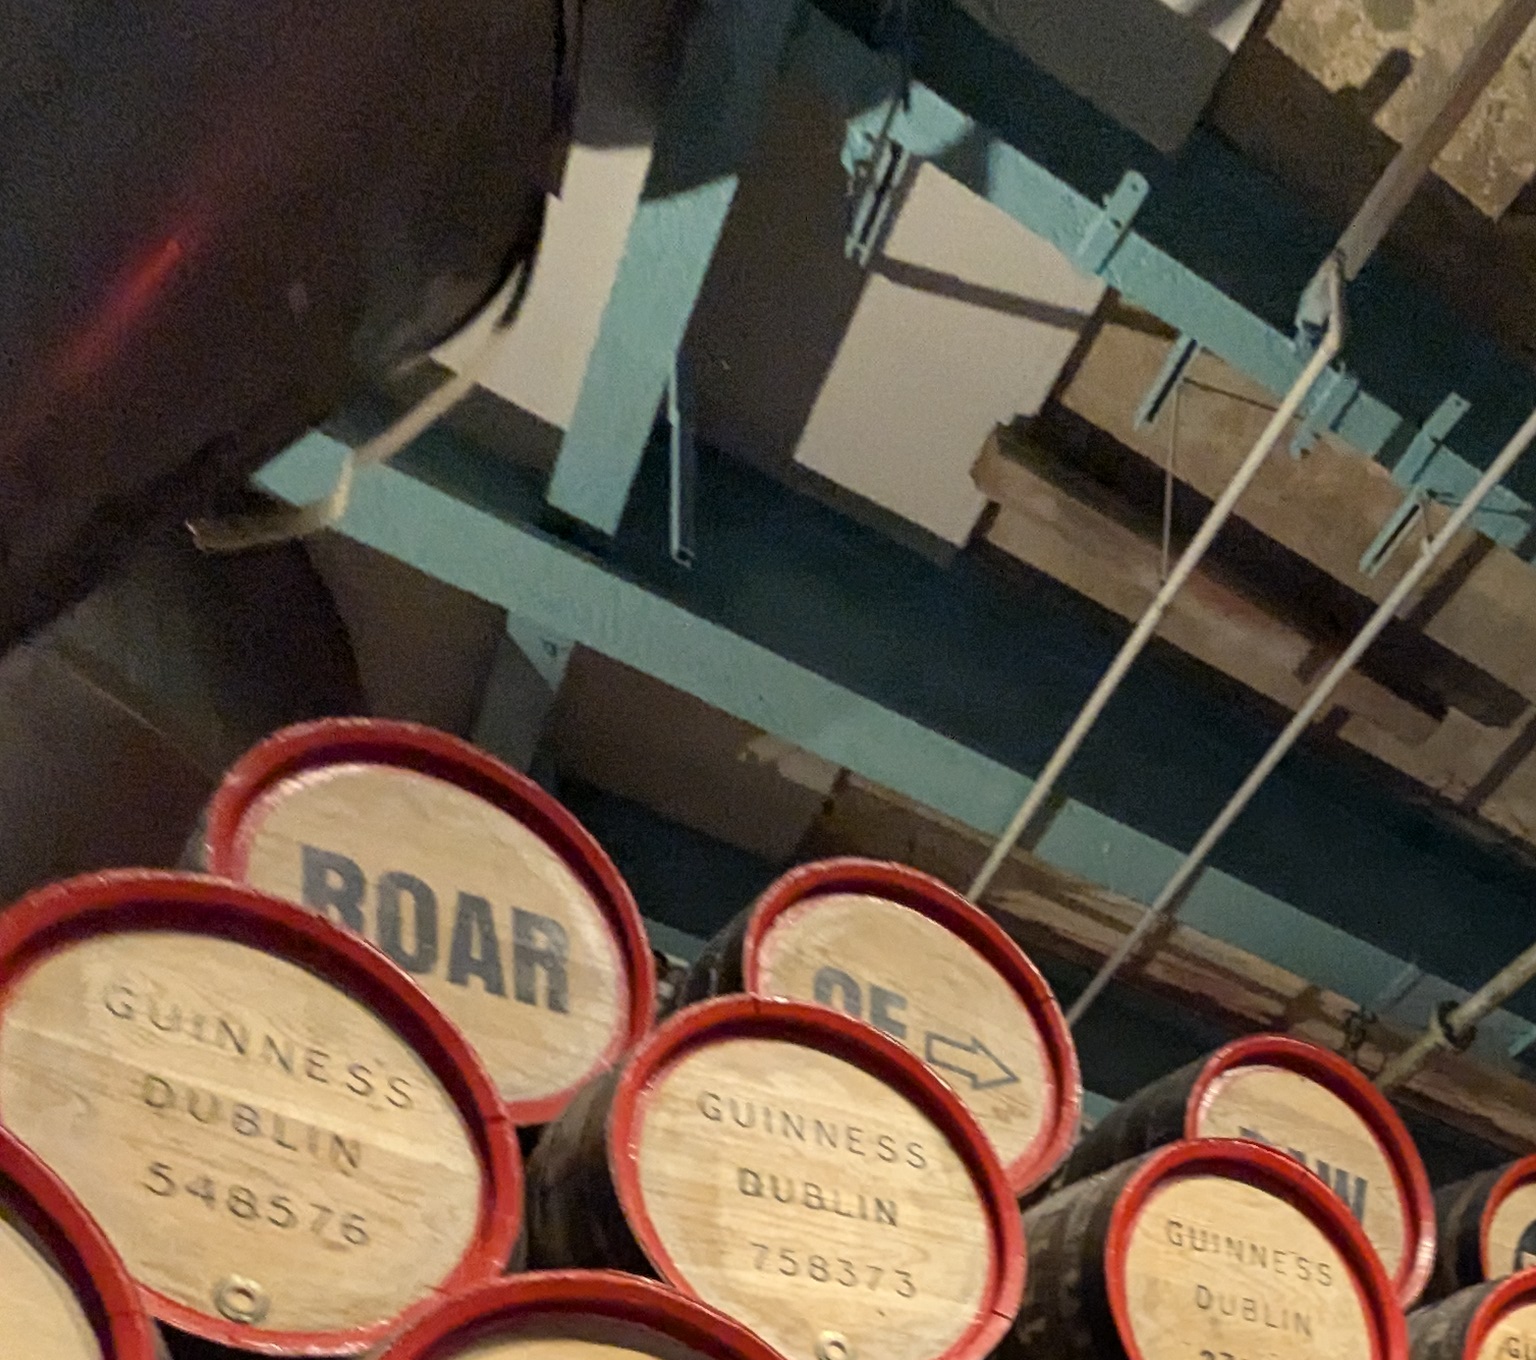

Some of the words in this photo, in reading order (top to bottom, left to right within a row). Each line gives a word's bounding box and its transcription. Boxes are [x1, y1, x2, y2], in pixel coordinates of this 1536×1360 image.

[302, 843, 570, 1014] ROAR
[103, 983, 415, 1111] GUINNESS
[142, 1073, 362, 1170] DUBLIN
[698, 1090, 928, 1170] GUINNESS
[142, 1161, 371, 1246] 548576
[737, 1166, 898, 1228] DUBLIN
[750, 1241, 918, 1299] 758373
[1166, 1218, 1333, 1288] GUINNESS
[1195, 1284, 1312, 1338] DUBLIN
